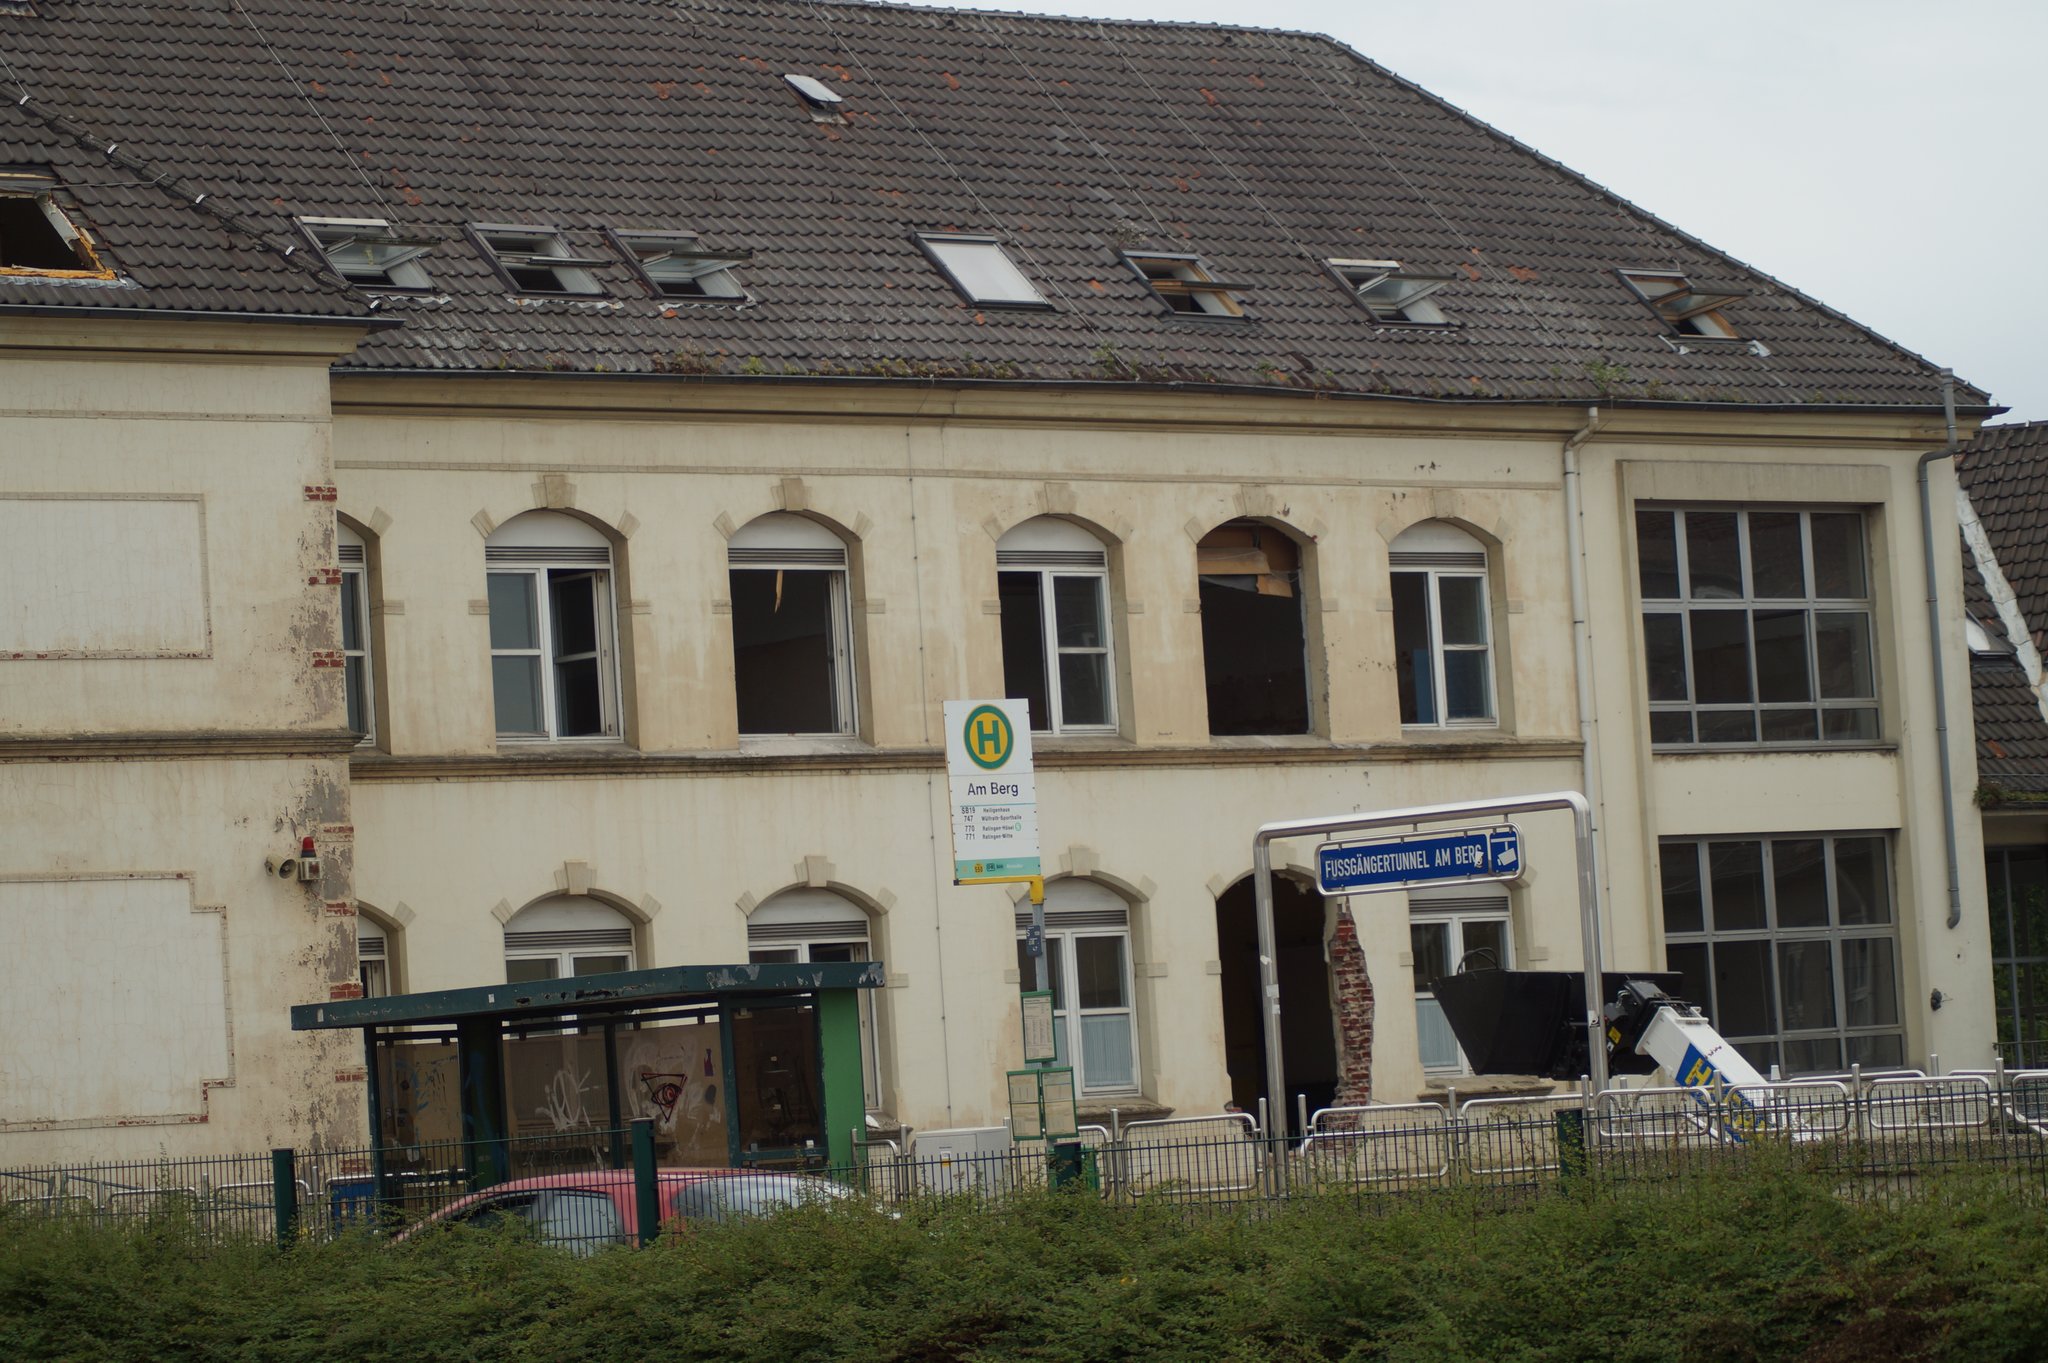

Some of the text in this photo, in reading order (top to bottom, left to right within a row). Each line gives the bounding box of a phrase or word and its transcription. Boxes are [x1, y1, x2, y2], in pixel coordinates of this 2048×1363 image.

[977, 719, 1001, 754] H
[967, 782, 1019, 797] Am Berg
[1325, 850, 1430, 878] FUSSGÄNGERTUNNEL
[1435, 848, 1451, 867] AM
